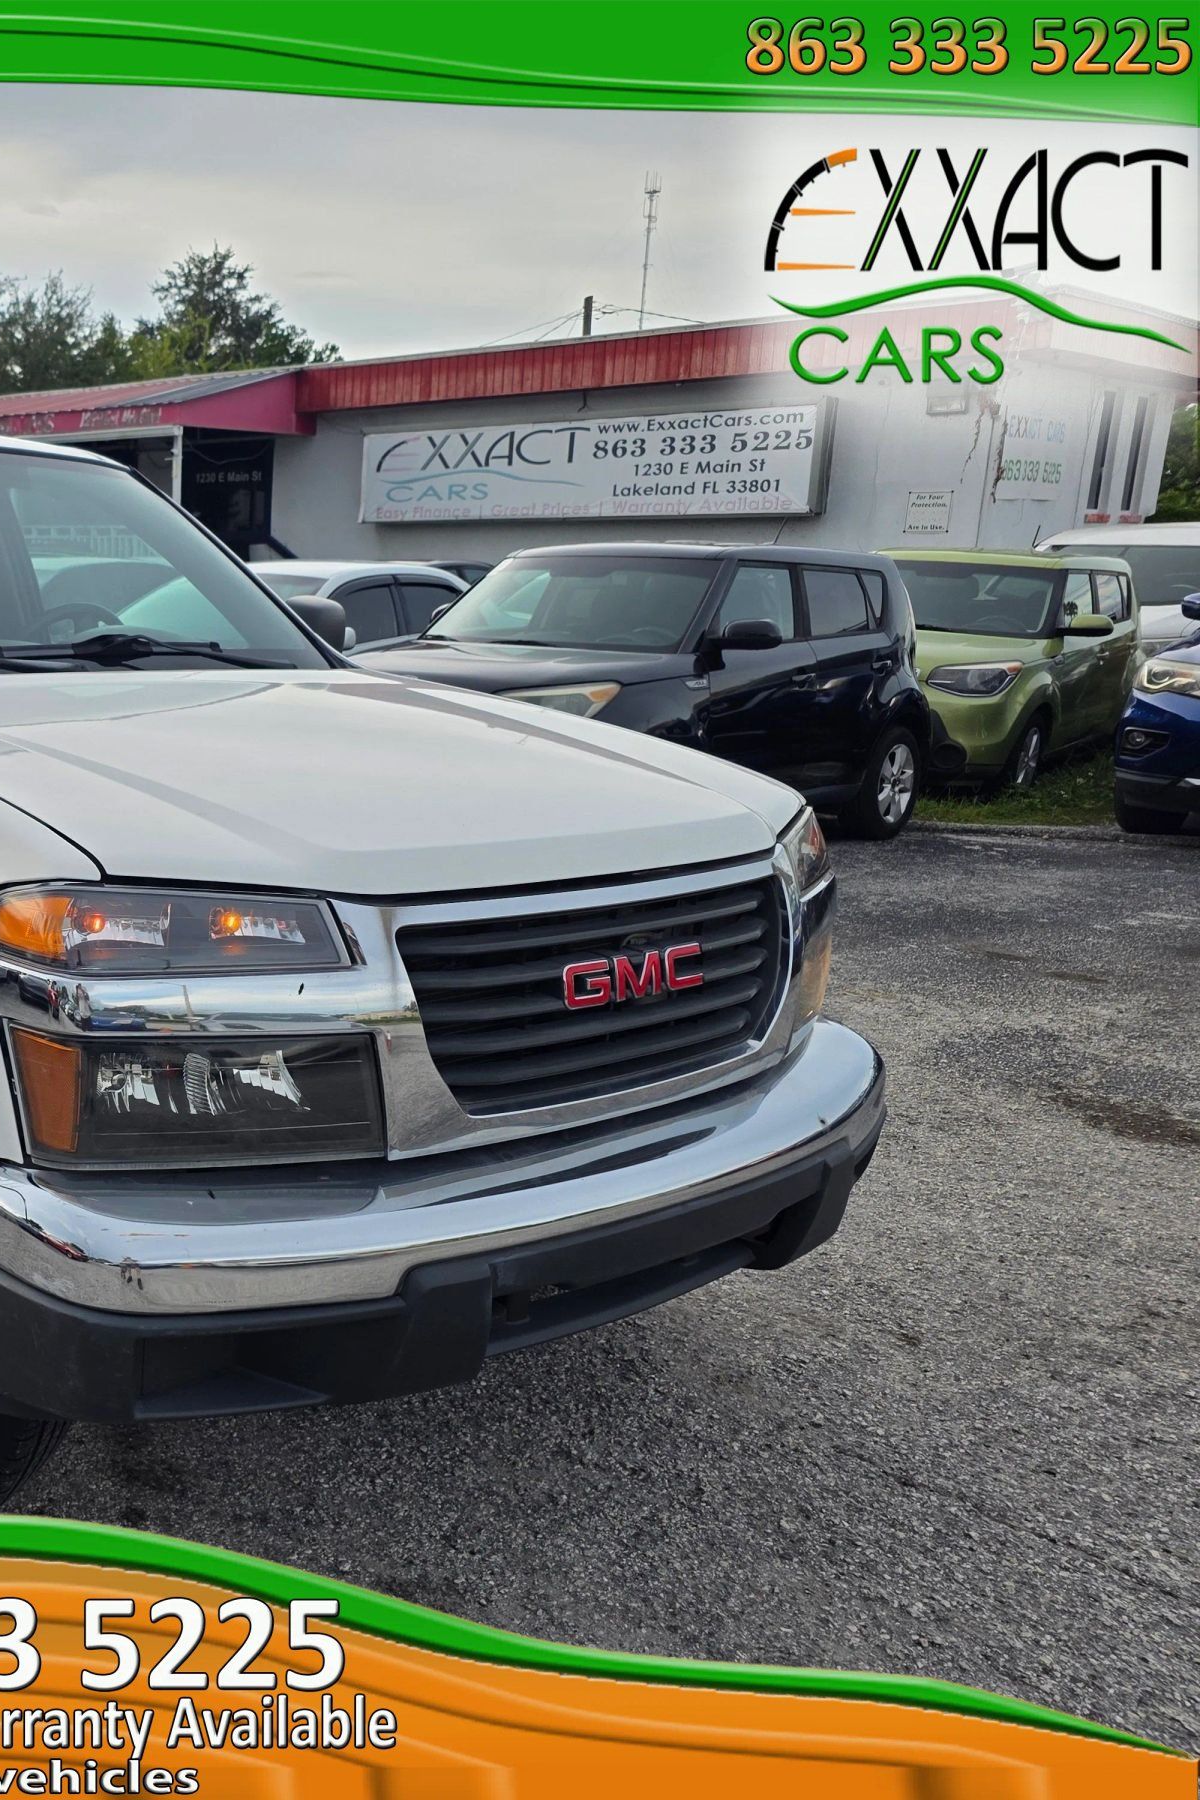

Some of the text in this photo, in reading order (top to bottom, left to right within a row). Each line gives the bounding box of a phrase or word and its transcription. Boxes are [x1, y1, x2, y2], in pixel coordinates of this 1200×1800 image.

[597, 410, 804, 435] www.ExxactCars.com
[375, 426, 591, 473] EXXACT
[592, 428, 814, 460] 863 333 5225
[217, 471, 225, 483] E
[227, 471, 250, 483] Main
[633, 458, 767, 477] 1230 E Main St
[385, 483, 489, 503] CARS
[612, 478, 781, 497] Lakeland FL 33801
[375, 506, 408, 521] Easy
[412, 505, 472, 519] Finance
[612, 499, 694, 517] Warranty
[562, 942, 705, 1010] GMC
